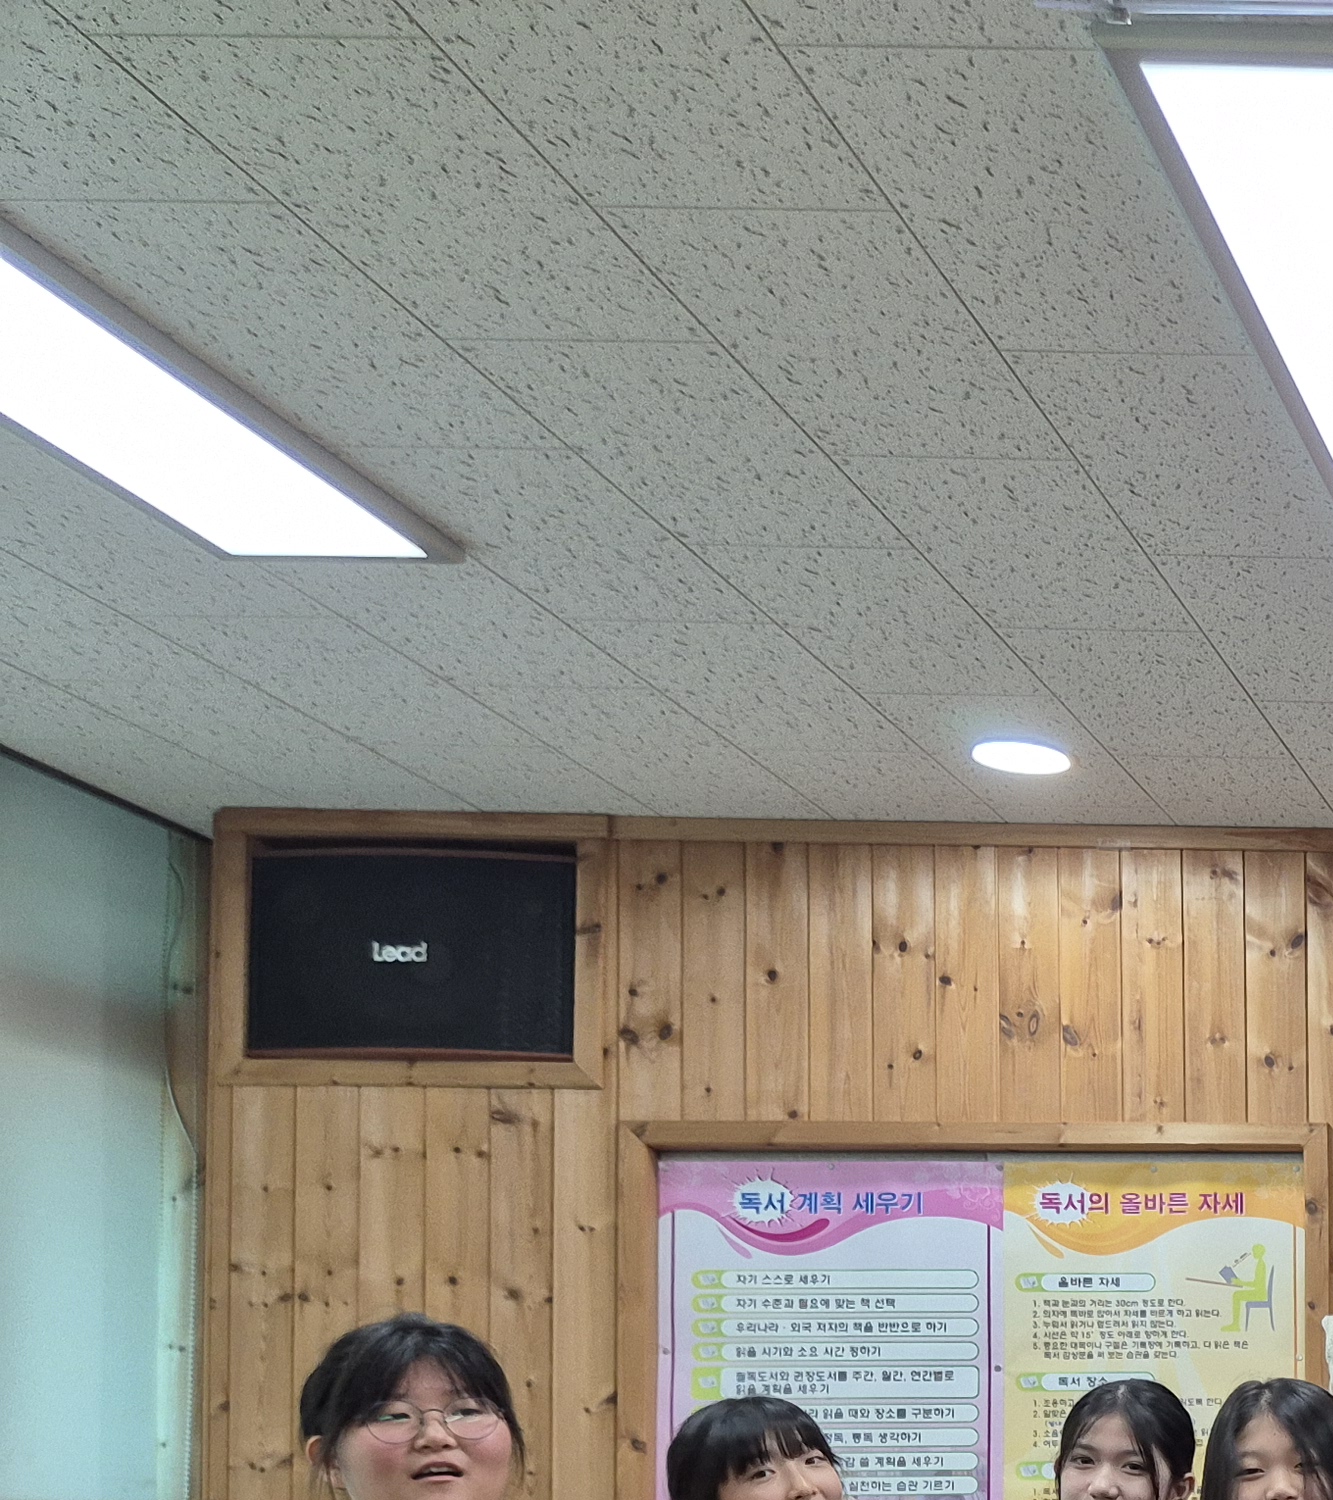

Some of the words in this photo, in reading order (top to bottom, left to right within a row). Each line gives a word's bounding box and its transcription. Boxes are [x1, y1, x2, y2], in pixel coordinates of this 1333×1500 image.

[372, 941, 427, 962] Lead
[738, 1191, 786, 1215] 독서
[797, 1191, 843, 1215] 계획
[852, 1191, 924, 1215] 세우기
[1039, 1191, 1110, 1215] 독서의
[1119, 1191, 1189, 1215] 올바른
[1198, 1191, 1245, 1215] 자세
[736, 1274, 757, 1286] 자기
[762, 1274, 794, 1286] 스스로
[799, 1274, 831, 1286] 세우기
[1058, 1277, 1093, 1288] 올바른
[1099, 1277, 1121, 1288] 자세
[736, 1298, 757, 1310] 자기
[762, 1298, 794, 1310] 수준과
[799, 1298, 831, 1310] 필요에
[835, 1298, 856, 1310] 맞는
[860, 1298, 871, 1310] 책
[875, 1298, 896, 1310] 선택
[736, 1322, 779, 1334] 우리나라
[790, 1322, 812, 1334] 외국
[816, 1322, 848, 1334] 저자의
[853, 1322, 873, 1334] 책을
[878, 1322, 921, 1334] 반반으로
[926, 1322, 947, 1334] 하기
[736, 1346, 757, 1358] 읽을
[762, 1346, 793, 1358] 시기와
[797, 1346, 818, 1358] 소요
[823, 1346, 845, 1358] 시간
[850, 1346, 881, 1358] 정하기
[1058, 1376, 1081, 1388] 독서
[736, 1385, 756, 1396] 읽을
[762, 1385, 792, 1396] 계획을
[799, 1385, 829, 1396] 세우기
[823, 1408, 844, 1420] 읽을
[849, 1408, 870, 1420] 때와
[874, 1408, 906, 1420] 장소를
[911, 1408, 955, 1420] 구분하기
[852, 1432, 873, 1444] 통독
[878, 1432, 921, 1444] 생각하기
[874, 1457, 906, 1468] 계획을
[911, 1457, 943, 1468] 세우기
[849, 1481, 892, 1492] 실천하는
[896, 1481, 918, 1492] 습관
[922, 1481, 955, 1492] 기르기
